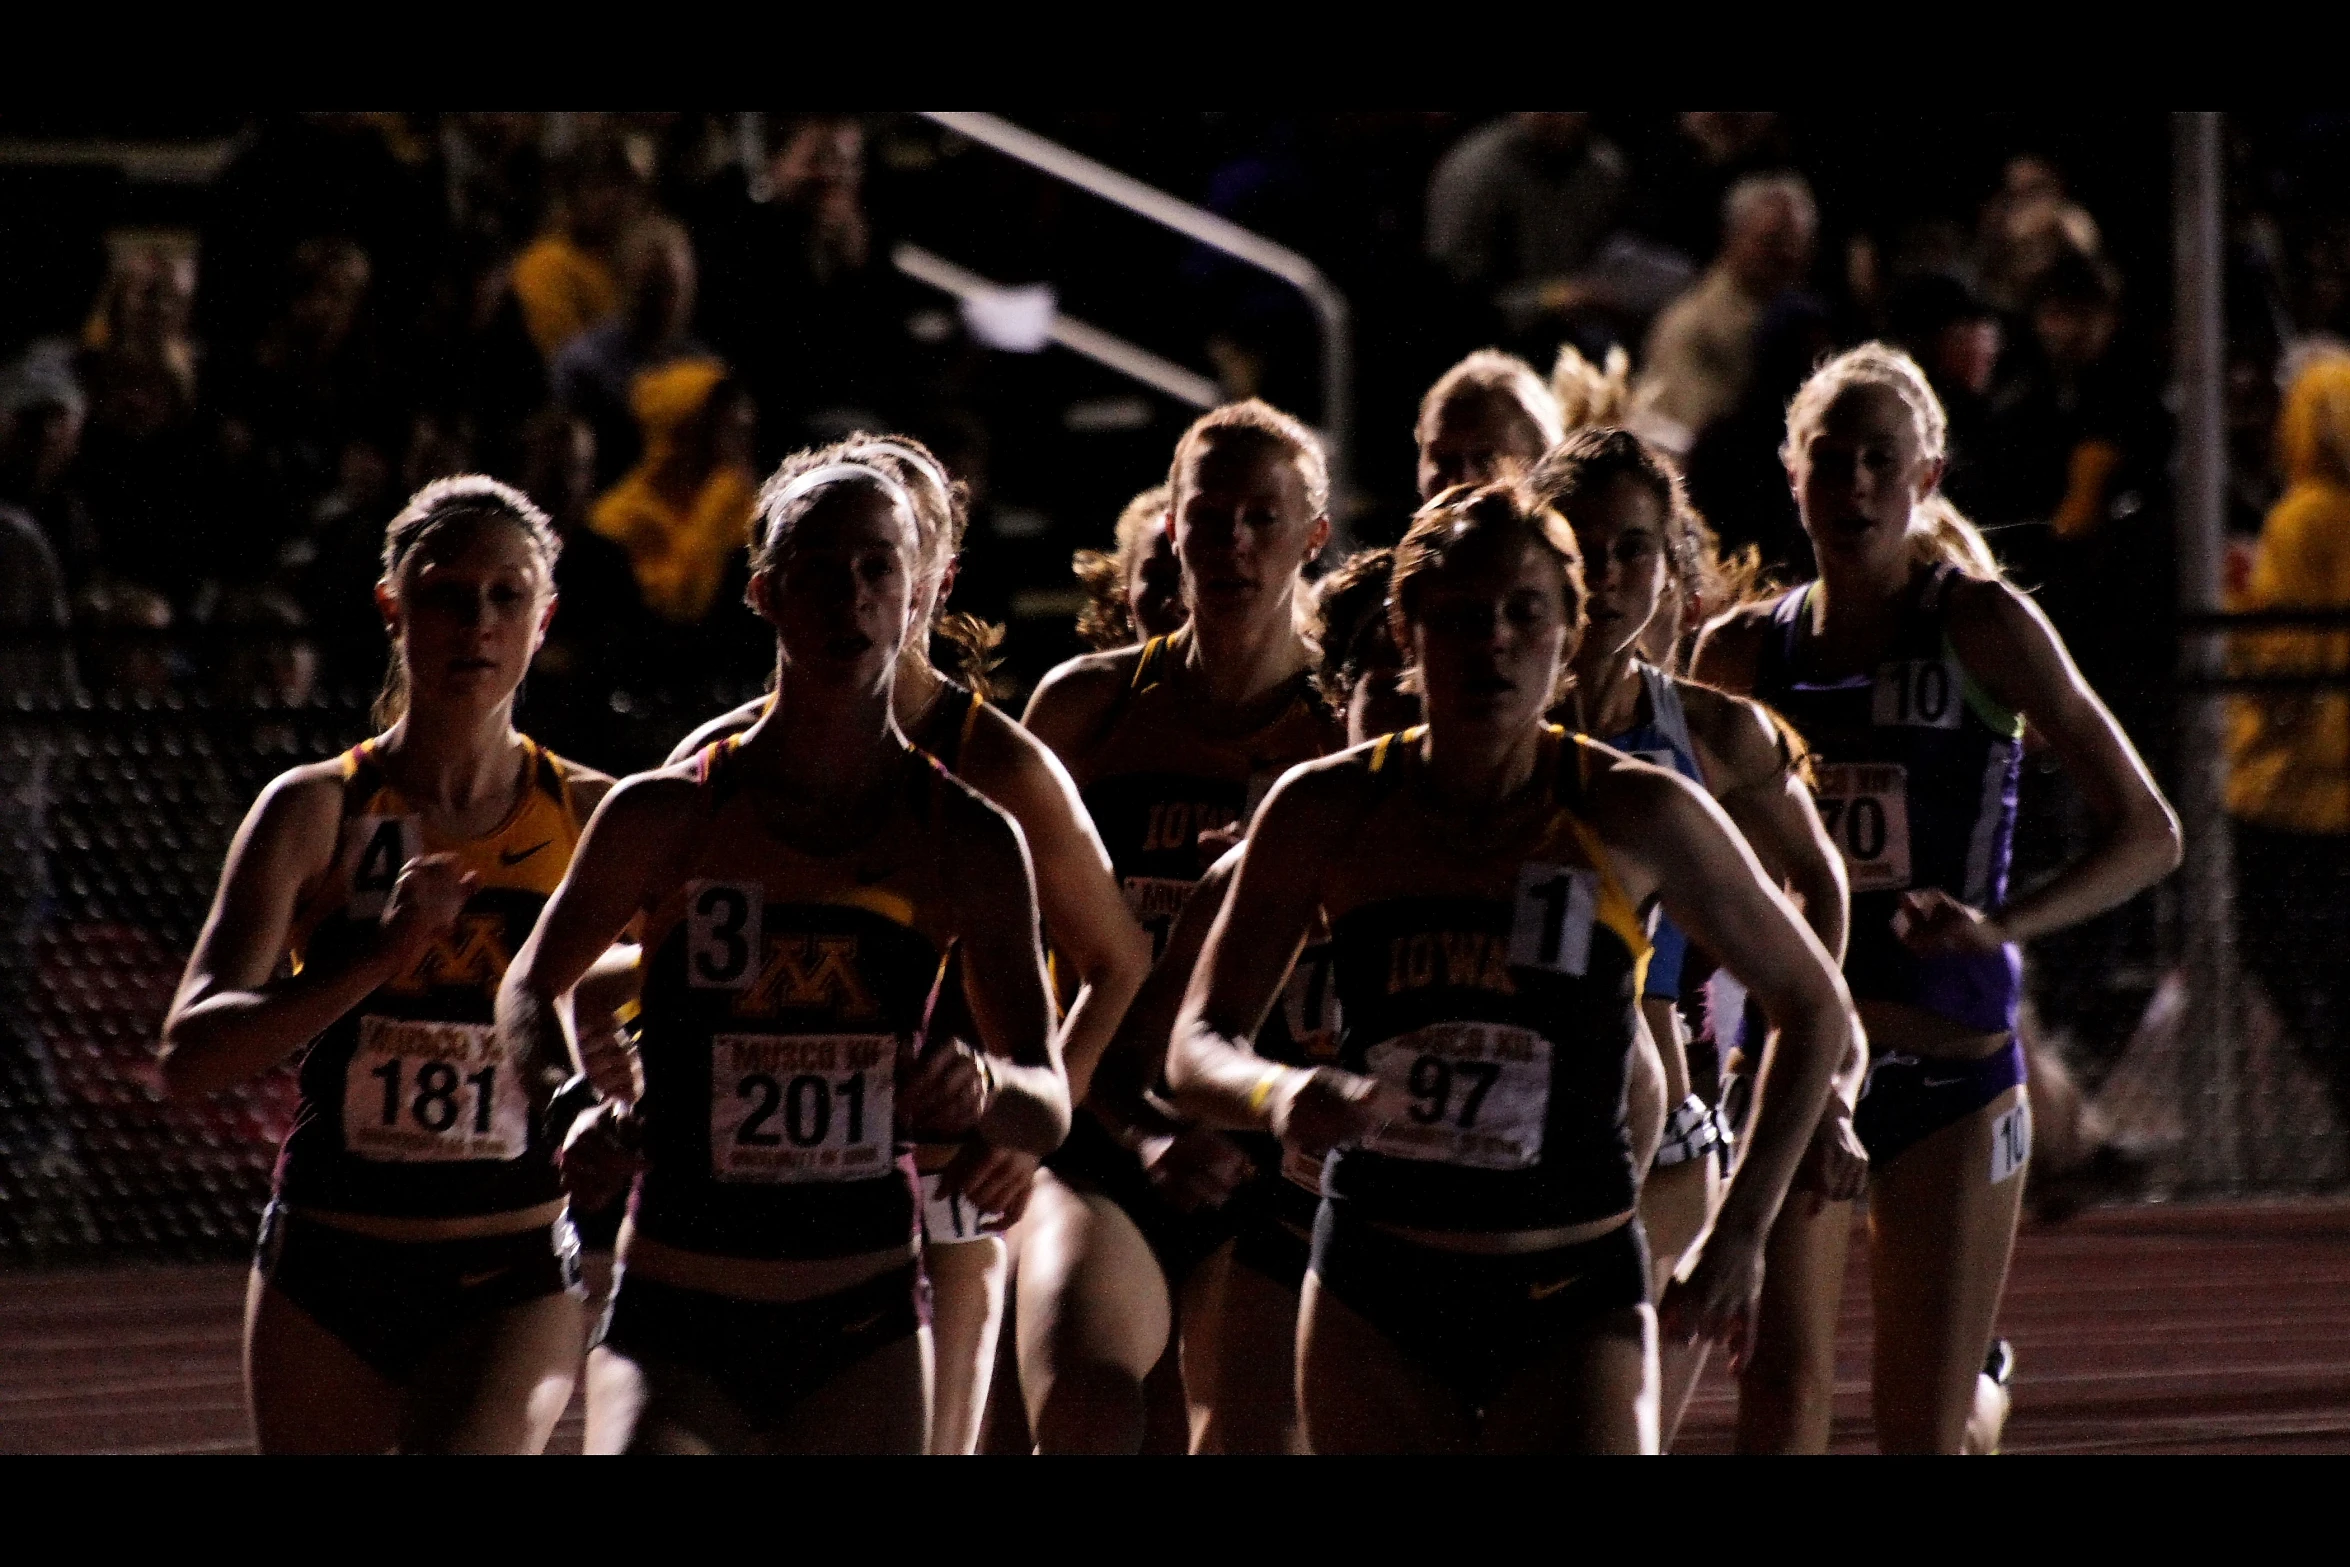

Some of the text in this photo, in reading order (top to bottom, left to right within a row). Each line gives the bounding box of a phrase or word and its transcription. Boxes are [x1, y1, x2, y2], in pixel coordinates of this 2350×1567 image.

[1889, 663, 1950, 722] 10
[356, 820, 405, 891] 4
[697, 887, 749, 983] 3
[1530, 876, 1569, 964] 1
[729, 932, 887, 1022] M
[732, 1040, 837, 1070] MUSCO
[1410, 1055, 1500, 1128] 97
[372, 1058, 495, 1133] 181
[737, 1071, 864, 1146] 201
